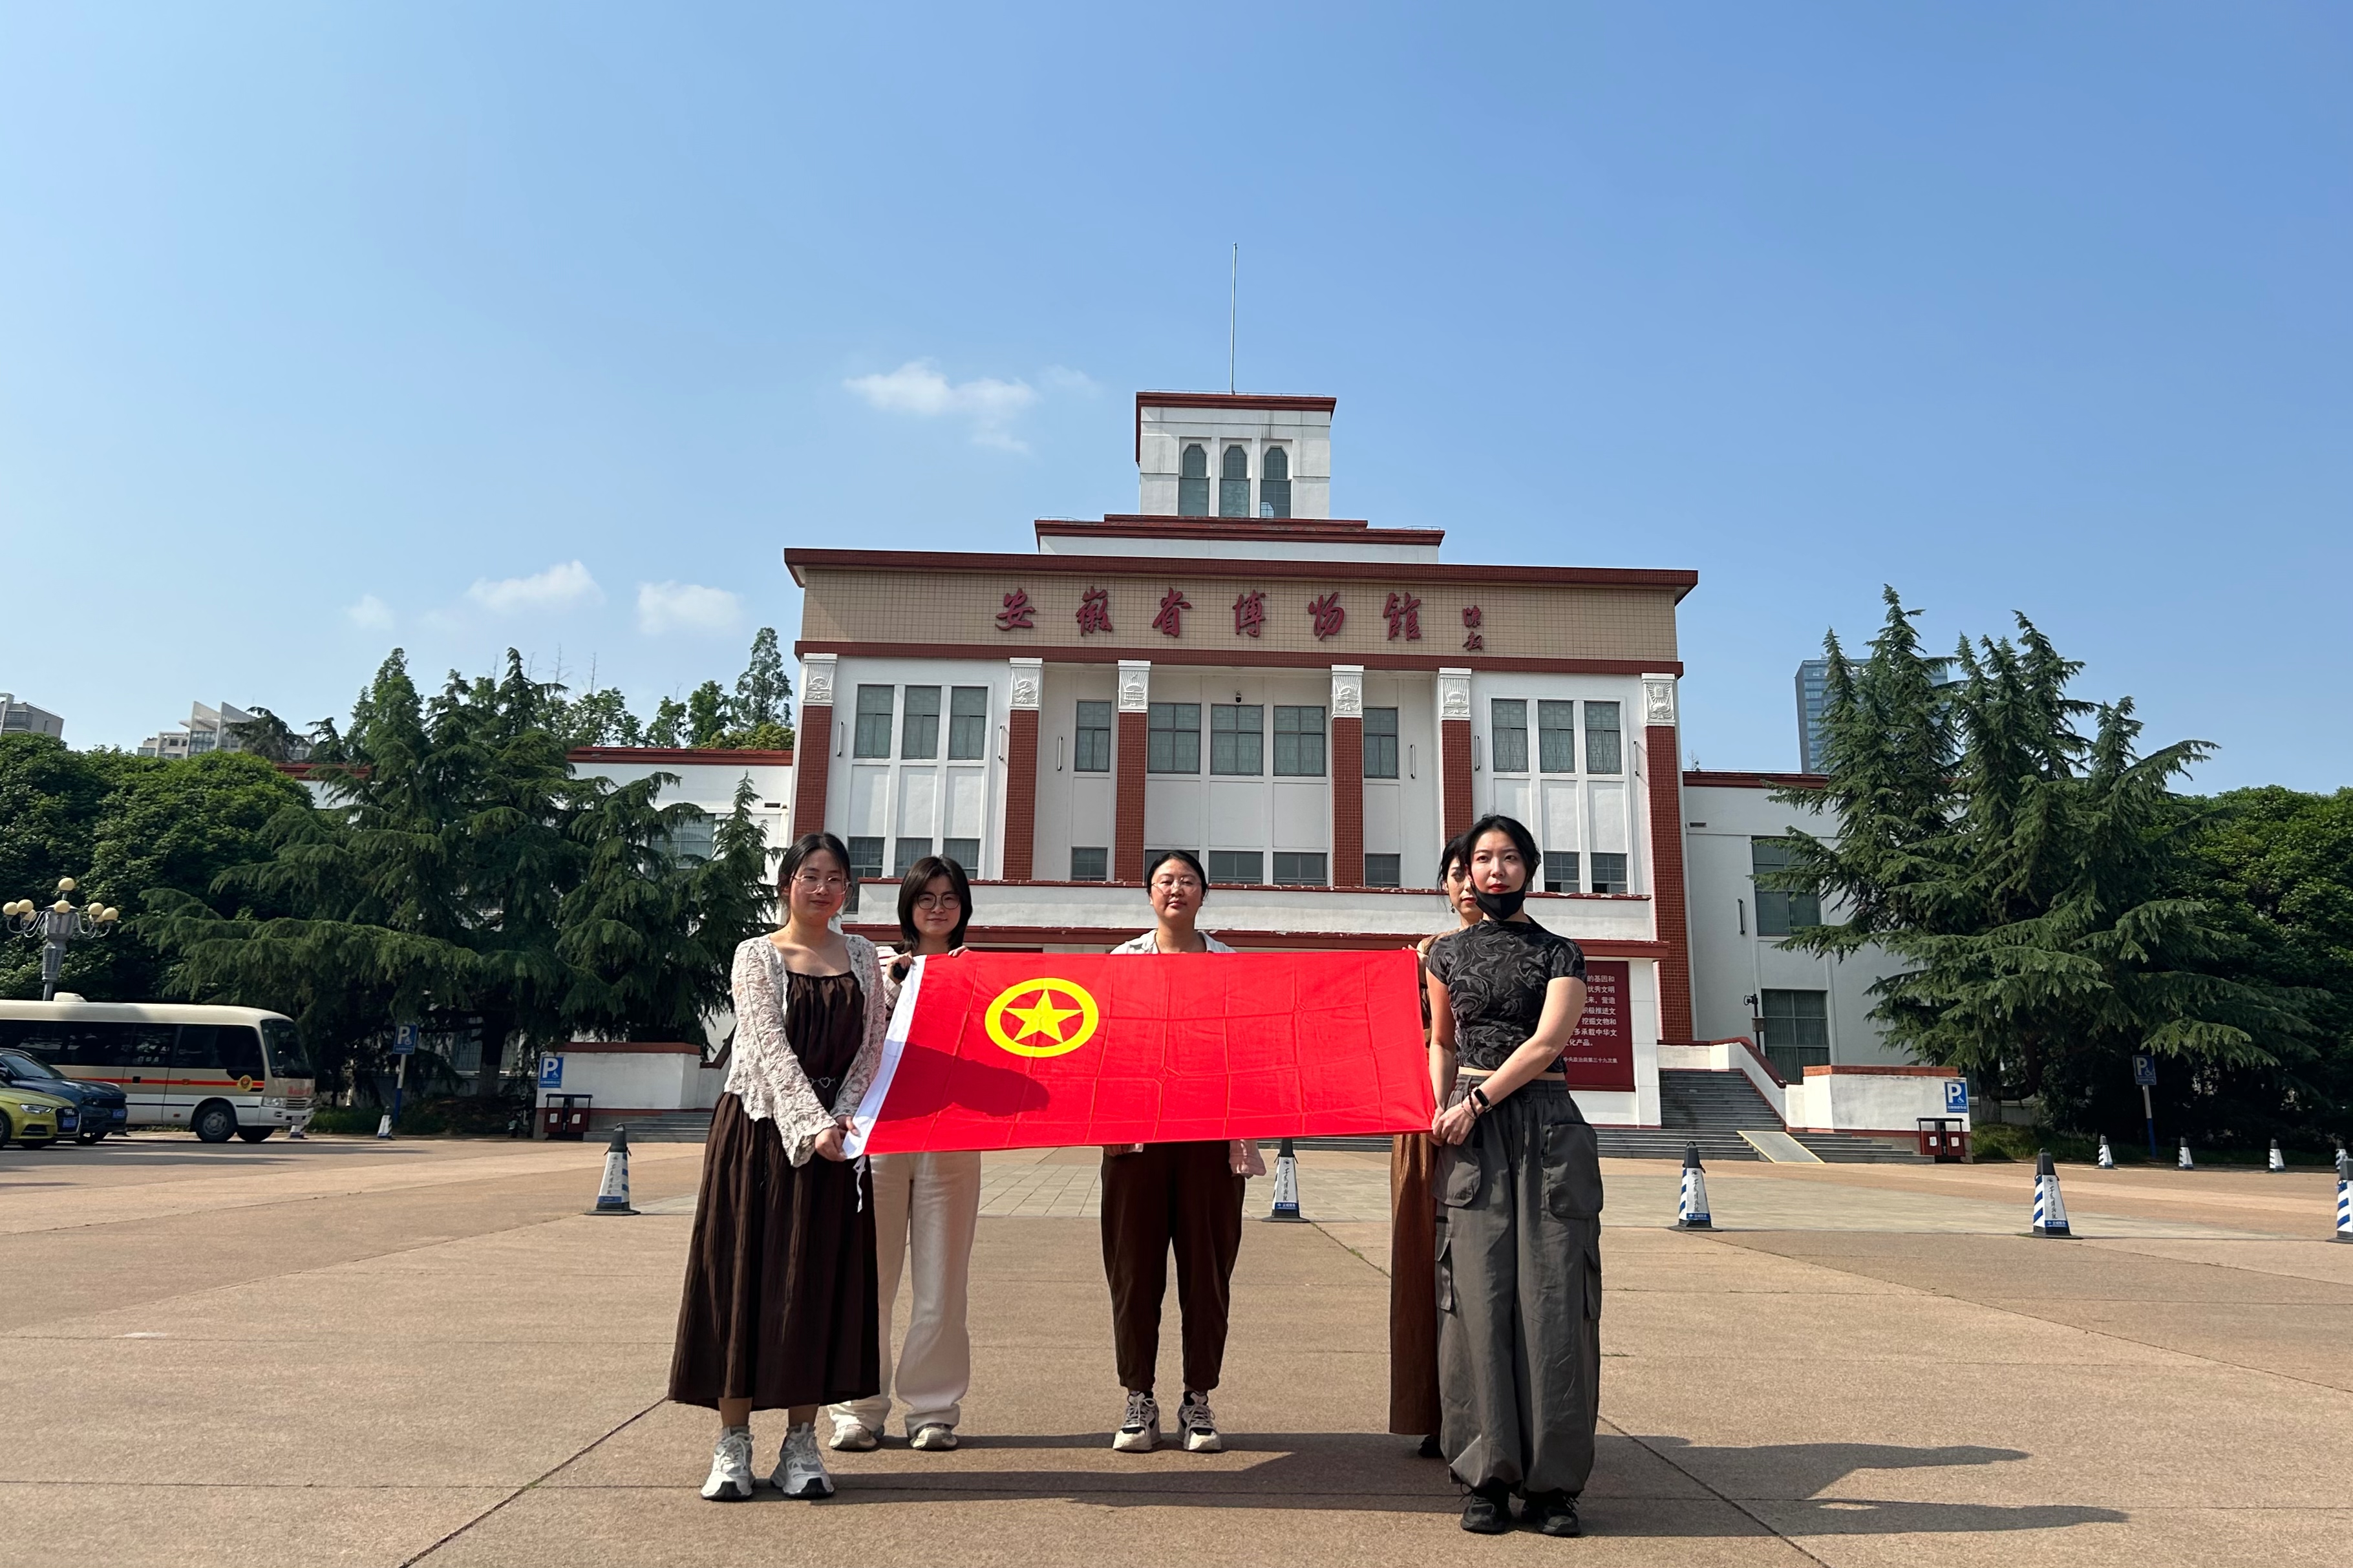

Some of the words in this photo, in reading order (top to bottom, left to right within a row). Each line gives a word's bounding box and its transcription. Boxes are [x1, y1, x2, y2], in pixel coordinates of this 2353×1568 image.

[1585, 996, 1615, 1004] 来，营造
[398, 1026, 410, 1044] P
[1571, 1028, 1617, 1037] 多承载中华文
[542, 1058, 559, 1078] P
[2136, 1057, 2147, 1075] P
[1947, 1083, 1962, 1103] P
